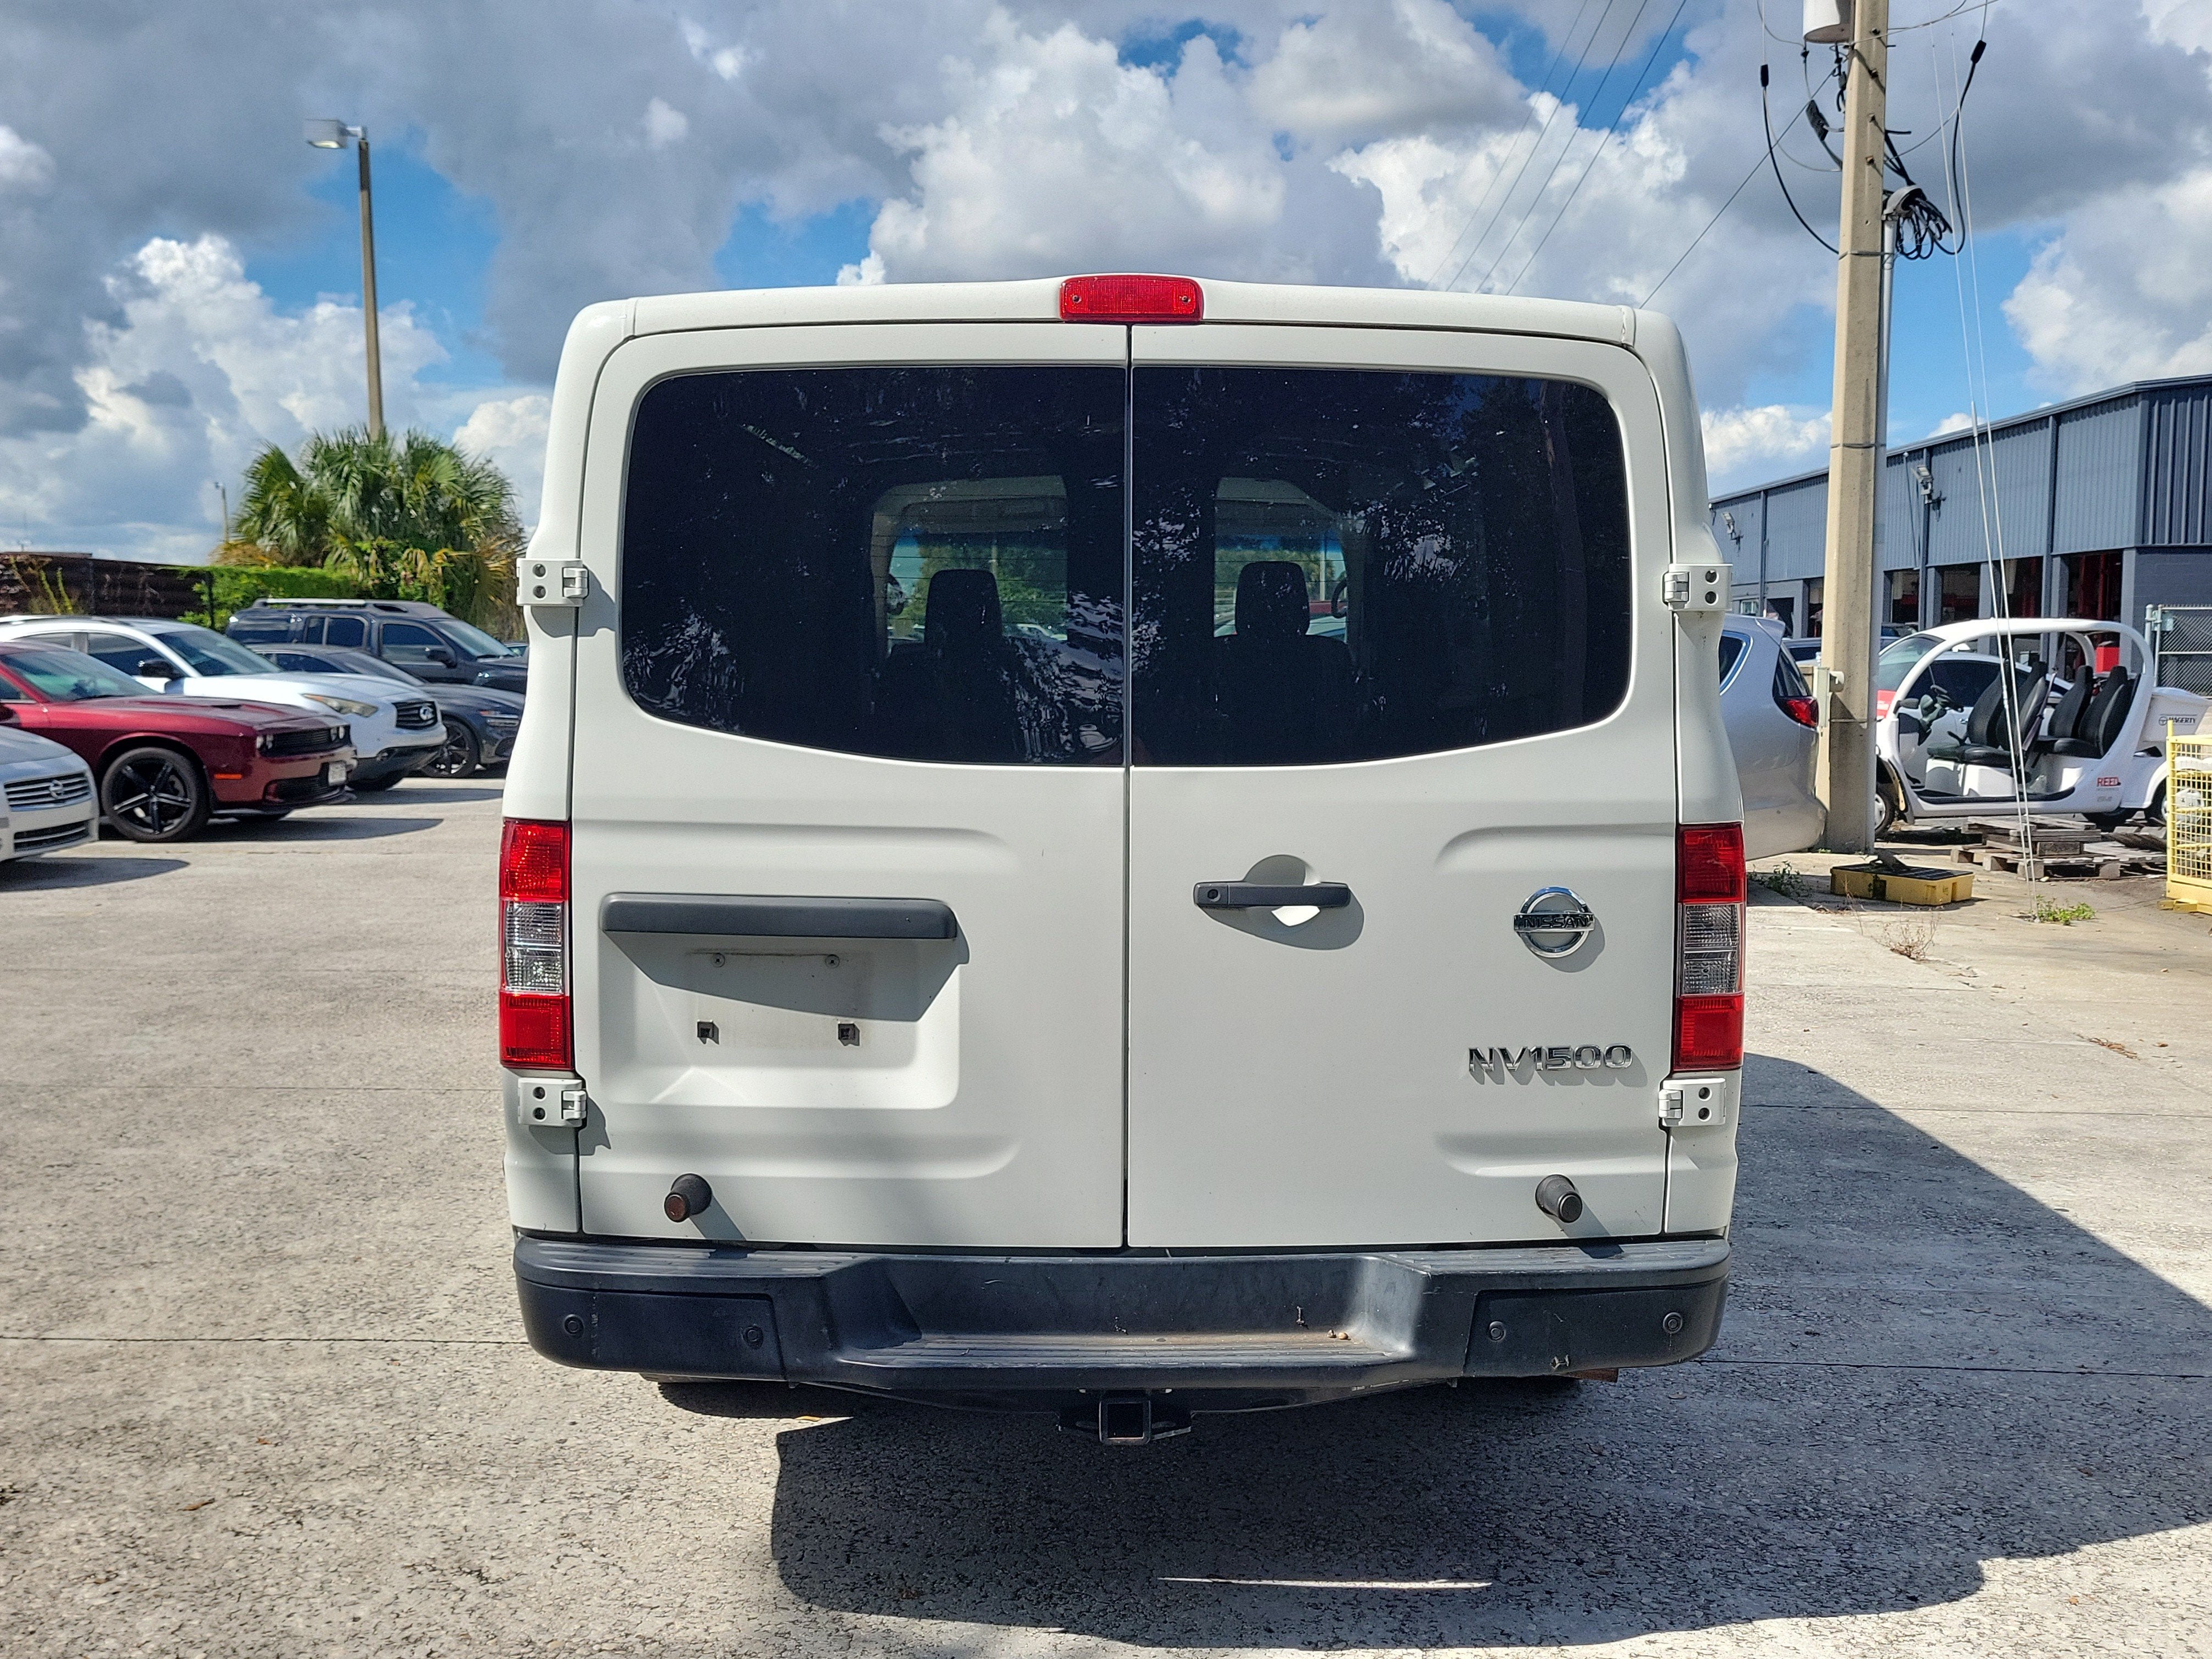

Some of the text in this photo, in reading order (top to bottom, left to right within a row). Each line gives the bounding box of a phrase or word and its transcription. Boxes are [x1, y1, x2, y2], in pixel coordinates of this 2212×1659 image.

[2097, 777, 2119, 787] REED
[1523, 916, 1588, 928] NISSAN
[1469, 1043, 1633, 1071] NV1500
